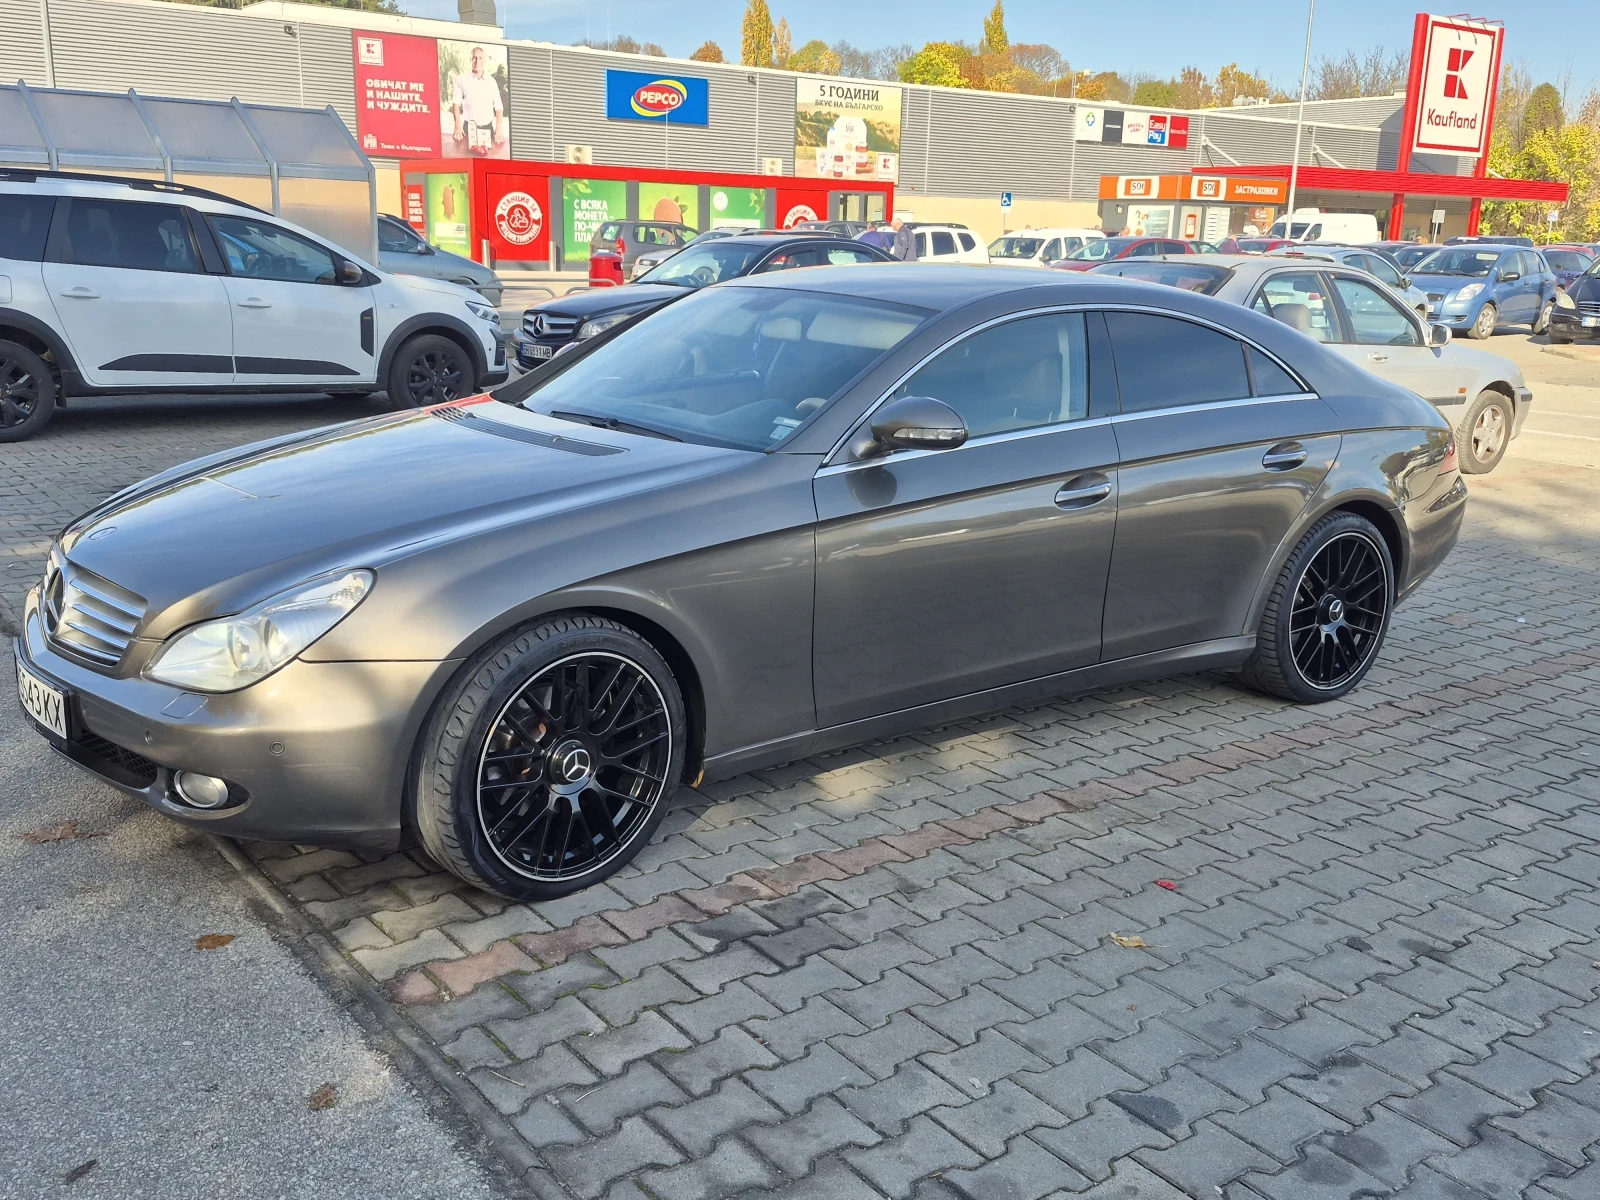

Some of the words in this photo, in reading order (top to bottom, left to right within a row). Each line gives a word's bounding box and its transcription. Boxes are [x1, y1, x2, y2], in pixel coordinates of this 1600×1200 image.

[365, 79, 407, 90] ОБИЧАТ
[409, 82, 424, 92] МЕ
[366, 89, 374, 99] И
[376, 91, 423, 103] НАШИТЕ,
[639, 91, 679, 106] PEPCO
[819, 84, 826, 97] 5
[829, 85, 879, 101] ГОДИНИ
[367, 100, 375, 110] И
[376, 101, 431, 114] ЧУЖДИТЕ.
[814, 99, 833, 108] ВКУС
[833, 100, 844, 108] НА
[845, 102, 884, 112] БЪЛГАРСКО
[1426, 107, 1478, 130] Kaufland
[1149, 119, 1166, 132] Easy
[1148, 130, 1162, 142] Pay
[1132, 182, 1144, 191] SDI
[1203, 182, 1214, 192] SDI
[1234, 185, 1278, 196] ЗАСТРАХОВКИ
[500, 195, 530, 212] СТАНЦИЯ
[529, 202, 538, 213] ЗА
[573, 199, 580, 210] С
[581, 199, 609, 211] ВСЯКА
[574, 210, 609, 221] МОНЕТА
